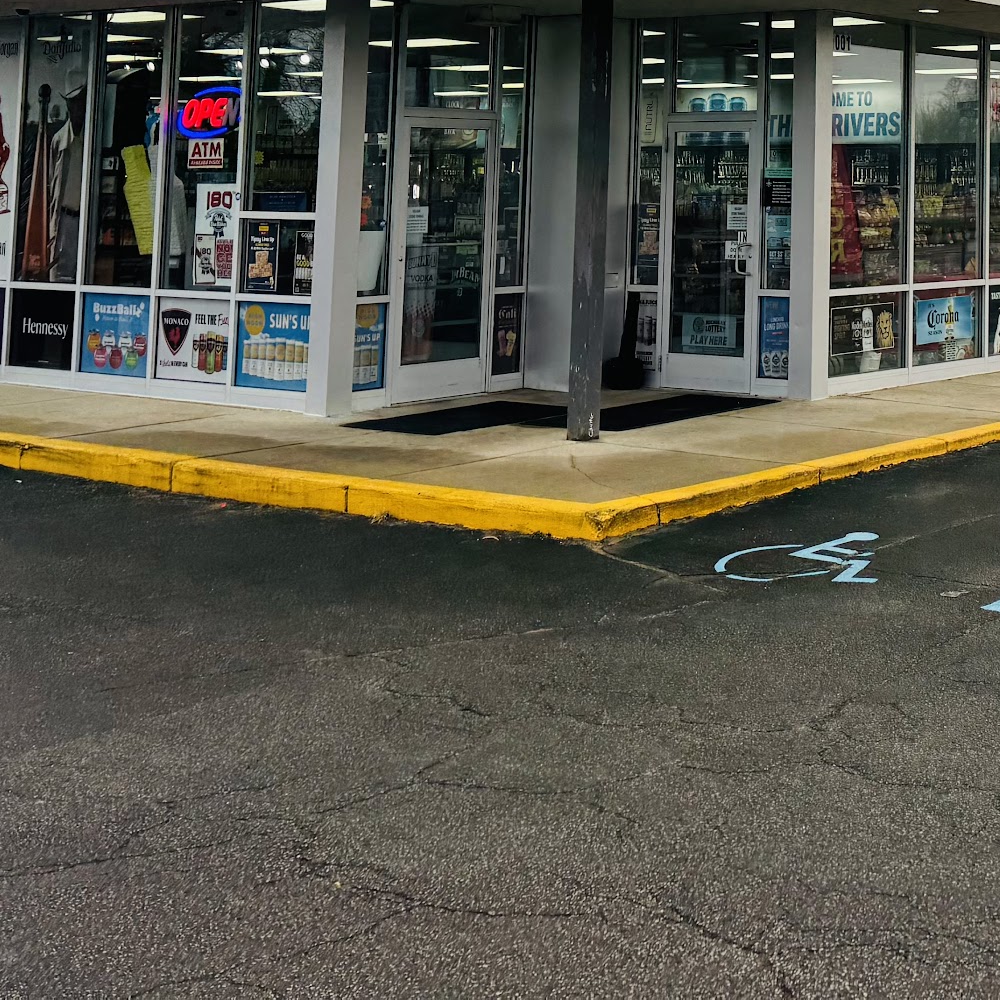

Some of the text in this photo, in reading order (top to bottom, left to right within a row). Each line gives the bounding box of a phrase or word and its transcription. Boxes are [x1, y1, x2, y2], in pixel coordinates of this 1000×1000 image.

[857, 91, 873, 107] TO
[182, 97, 240, 129] OPEN
[832, 111, 900, 137] RIVERS
[191, 141, 221, 158] ATM
[163, 316, 191, 327] MONACO
[194, 313, 207, 325] FEEL
[207, 314, 217, 326] THE
[269, 313, 299, 330] SUN'S
[927, 309, 959, 330] Corona
[22, 317, 69, 340] Hennessy
[690, 334, 728, 346] PLAY HERE
